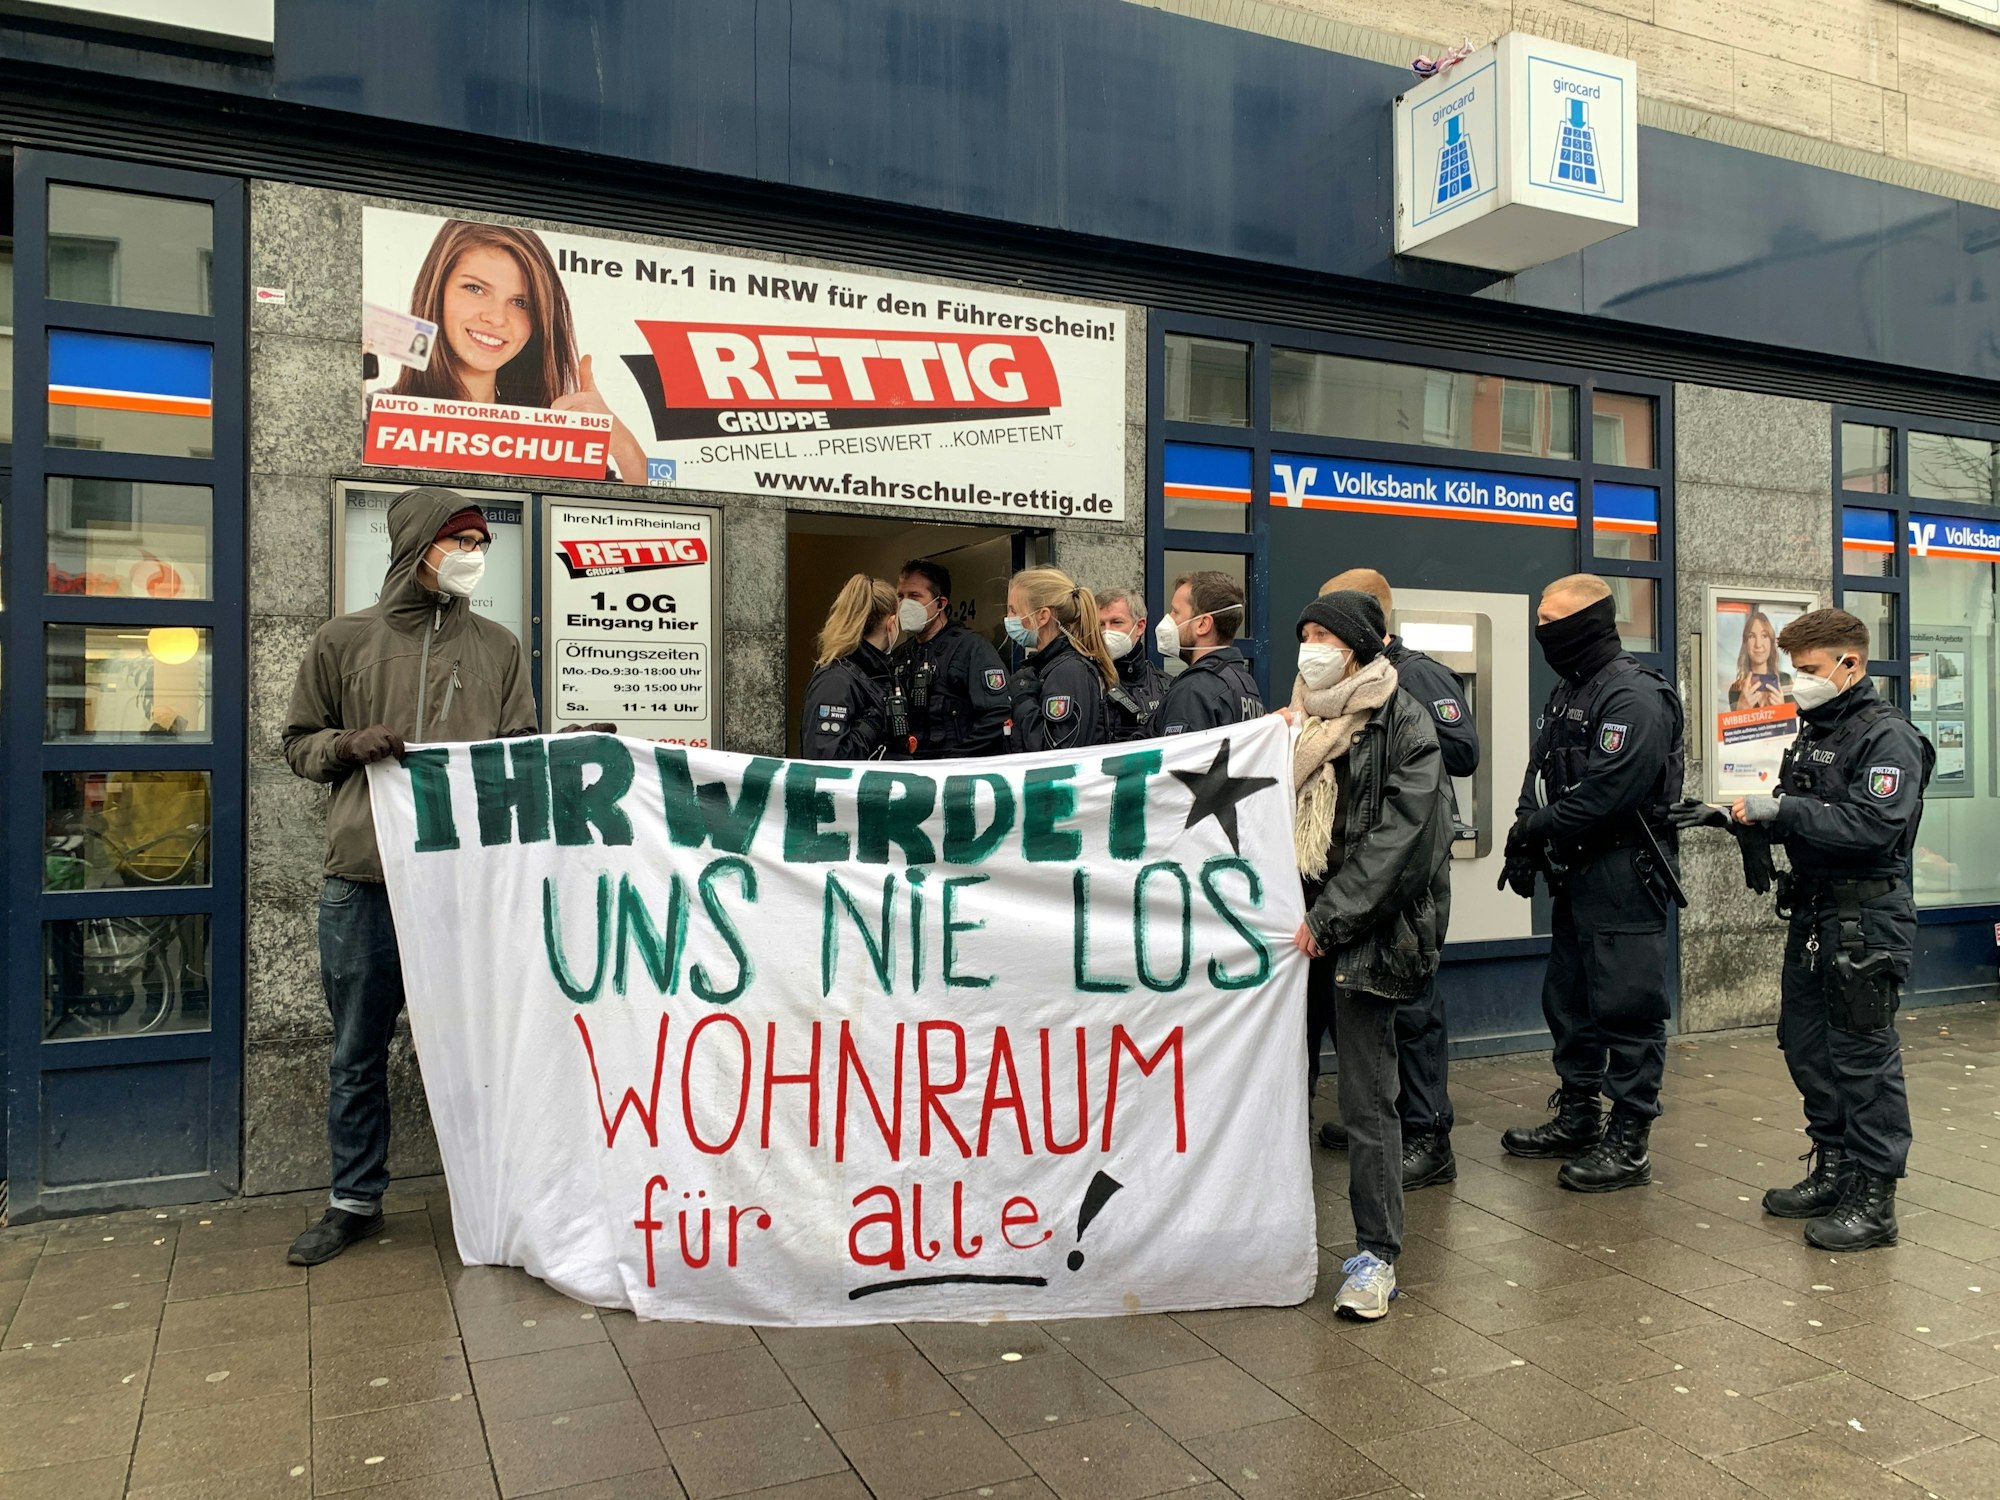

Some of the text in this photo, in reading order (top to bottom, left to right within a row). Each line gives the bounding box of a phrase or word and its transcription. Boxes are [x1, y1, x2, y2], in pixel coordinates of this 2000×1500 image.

[1553, 77, 1600, 99] girocard
[1432, 87, 1475, 126] girocard
[558, 249, 1115, 341] Ihre Nr.1 in NRW für den Führerschein!
[686, 331, 1029, 403] RETTIG
[374, 398, 418, 412] AUTO
[433, 403, 520, 421] MOTORRAD
[534, 411, 567, 425] LKW
[580, 416, 610, 429] BUS
[717, 410, 830, 433] GRUPPE
[376, 426, 605, 466] FAHRSCHULE
[683, 424, 1063, 465] ...SCHNELL ...PREISWERT ...KOMPETENT
[650, 463, 673, 480] TQ
[347, 495, 390, 509] Recht
[754, 471, 1113, 516] www.fahrschule-rettig.de
[1333, 470, 1574, 512] Volksbank Köln Bonn eG
[563, 513, 590, 524] Ihre
[617, 516, 633, 527] im
[635, 518, 700, 531] Rheinland
[575, 540, 699, 566] RETTIG
[586, 567, 625, 577] GRUPPE
[591, 592, 676, 613] 1. OG
[567, 614, 699, 632] Eingang hier
[566, 642, 699, 661] Öffnungszeiten
[680, 667, 702, 676] Uhr
[562, 684, 702, 692] Fr. 9:30 15:00 Uhr
[566, 703, 589, 712] Sa.
[674, 704, 699, 712] Uhr
[403, 734, 1164, 865] IHR WERDET
[542, 857, 759, 1004] UNS
[1072, 857, 1277, 994] LOS
[574, 1012, 1187, 1163] WOHNRAUM
[634, 1175, 771, 1288] für
